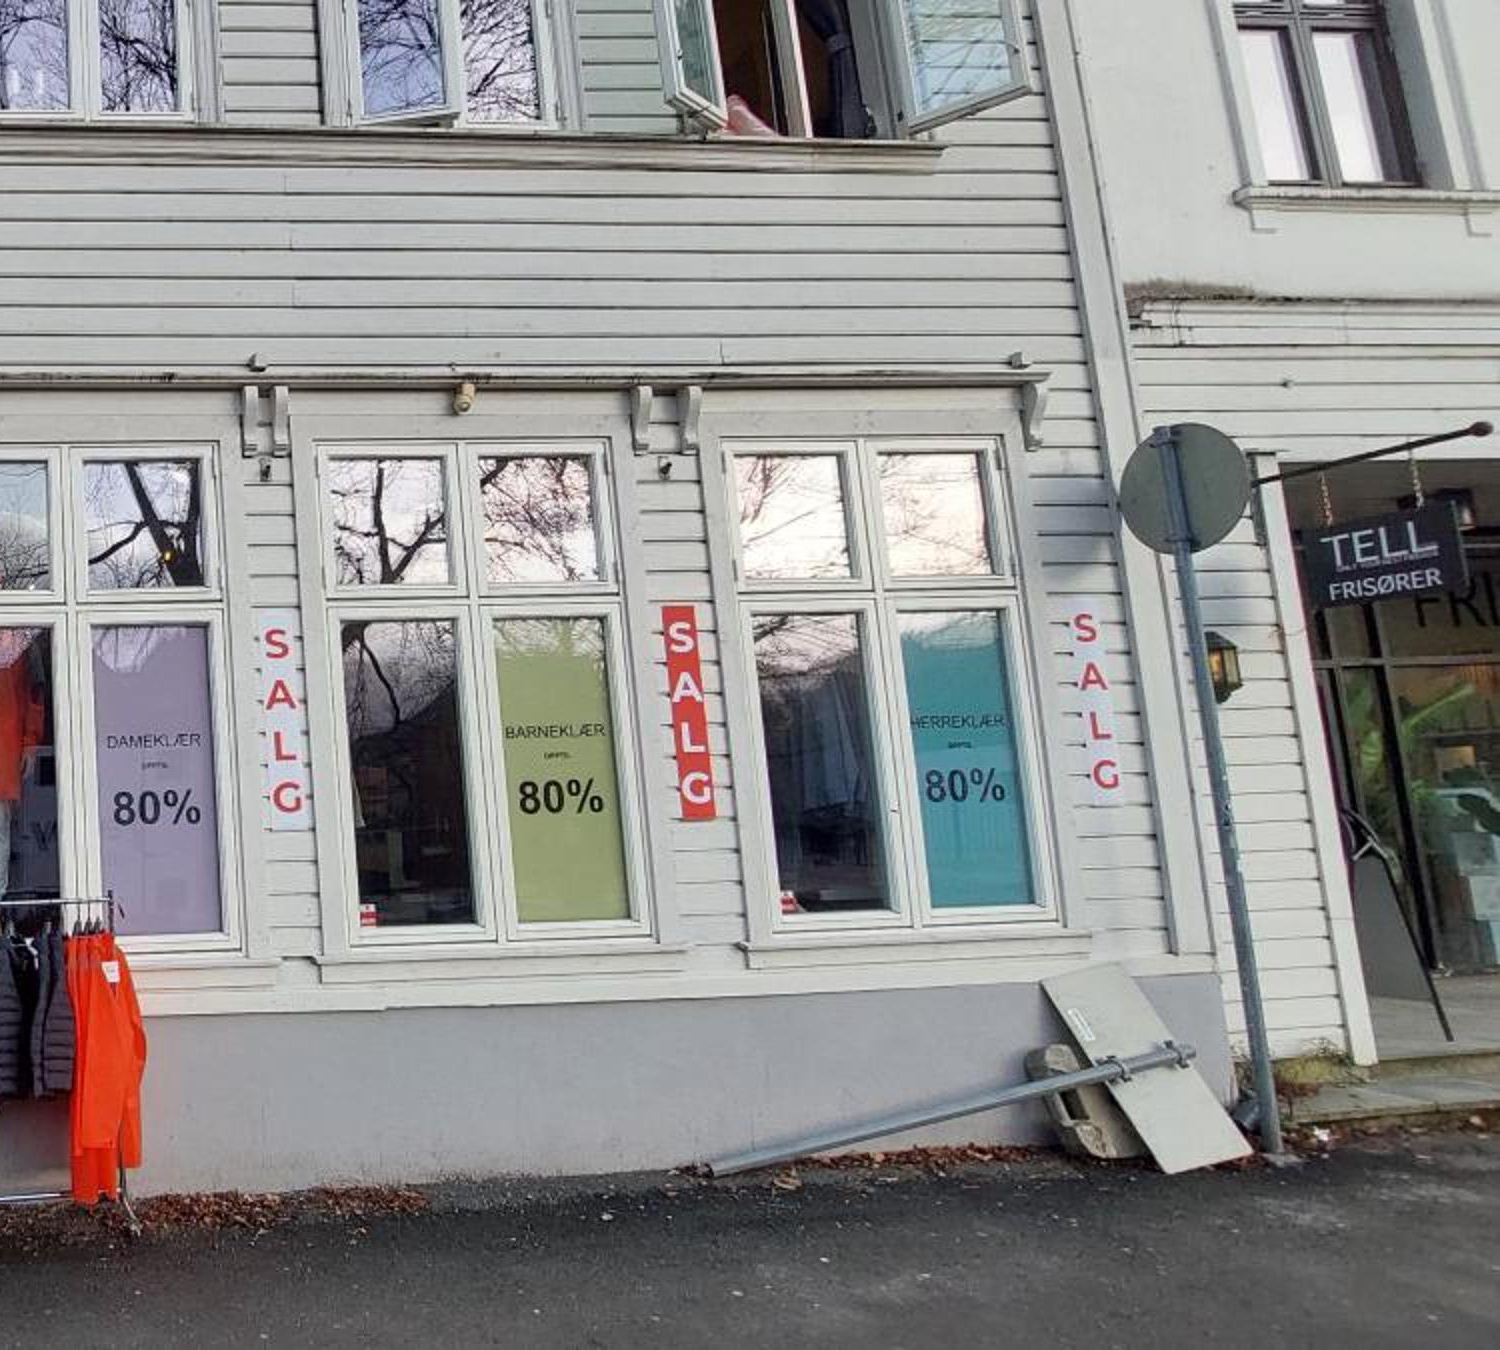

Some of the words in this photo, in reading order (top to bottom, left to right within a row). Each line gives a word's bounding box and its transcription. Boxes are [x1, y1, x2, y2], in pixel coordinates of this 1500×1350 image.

[1318, 520, 1439, 568] TELL
[1329, 567, 1443, 601] FRISØRER
[668, 621, 711, 805] SALG
[1074, 613, 1120, 790] SALG
[263, 628, 303, 814] SALG
[505, 723, 606, 740] BARNEKLÆR
[106, 733, 201, 750] DAMEKLÆR
[519, 777, 604, 815] 80%
[925, 767, 1006, 804] 80%
[113, 788, 201, 826] 80%
